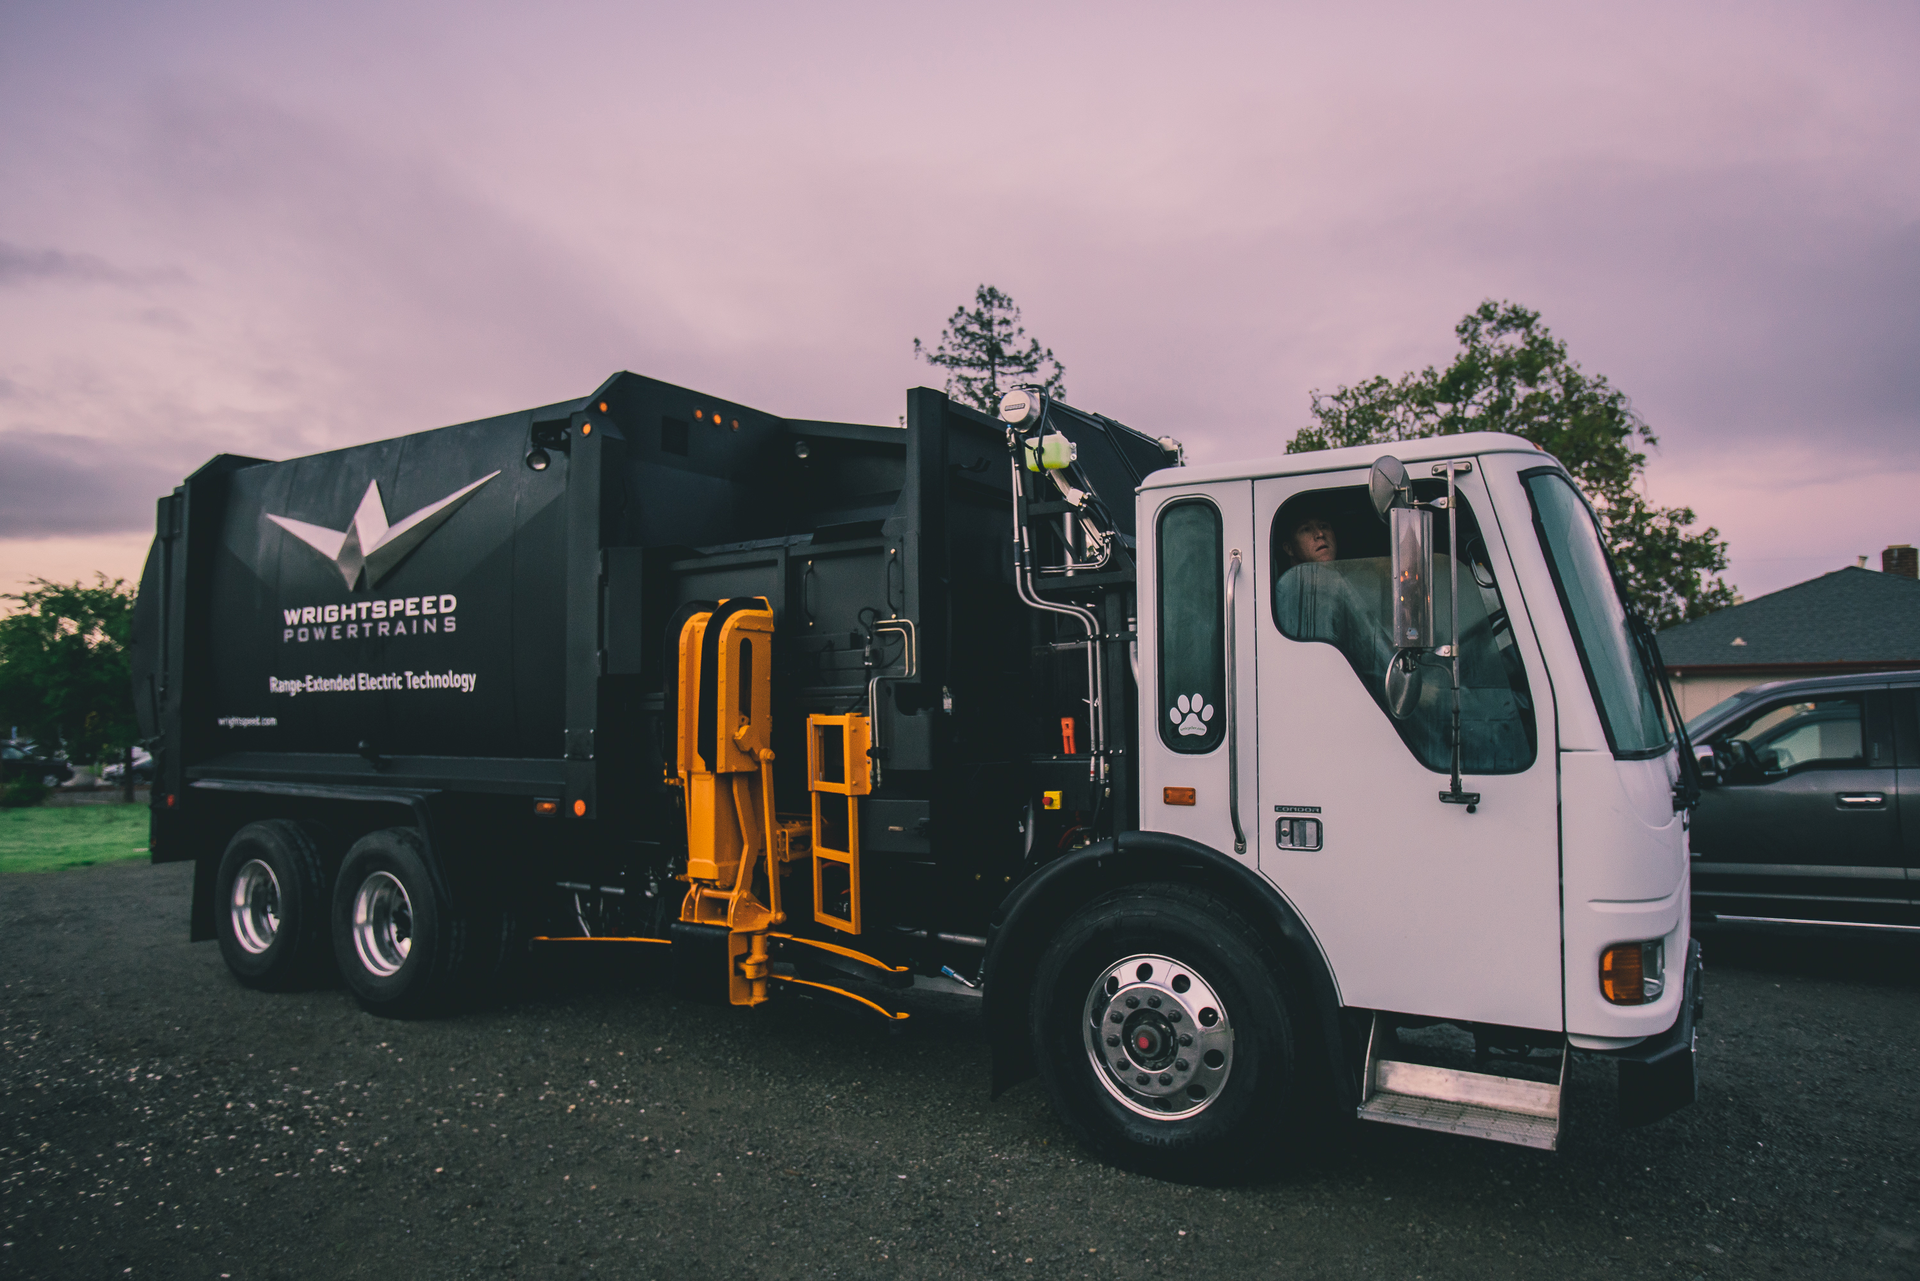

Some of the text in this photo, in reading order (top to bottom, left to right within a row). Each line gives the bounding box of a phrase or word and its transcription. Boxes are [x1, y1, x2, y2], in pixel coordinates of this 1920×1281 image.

[283, 594, 457, 626] WRIGHTSPEED
[283, 616, 457, 643] POWERTRAINS
[269, 670, 477, 697] Range-Extended Electric Technology
